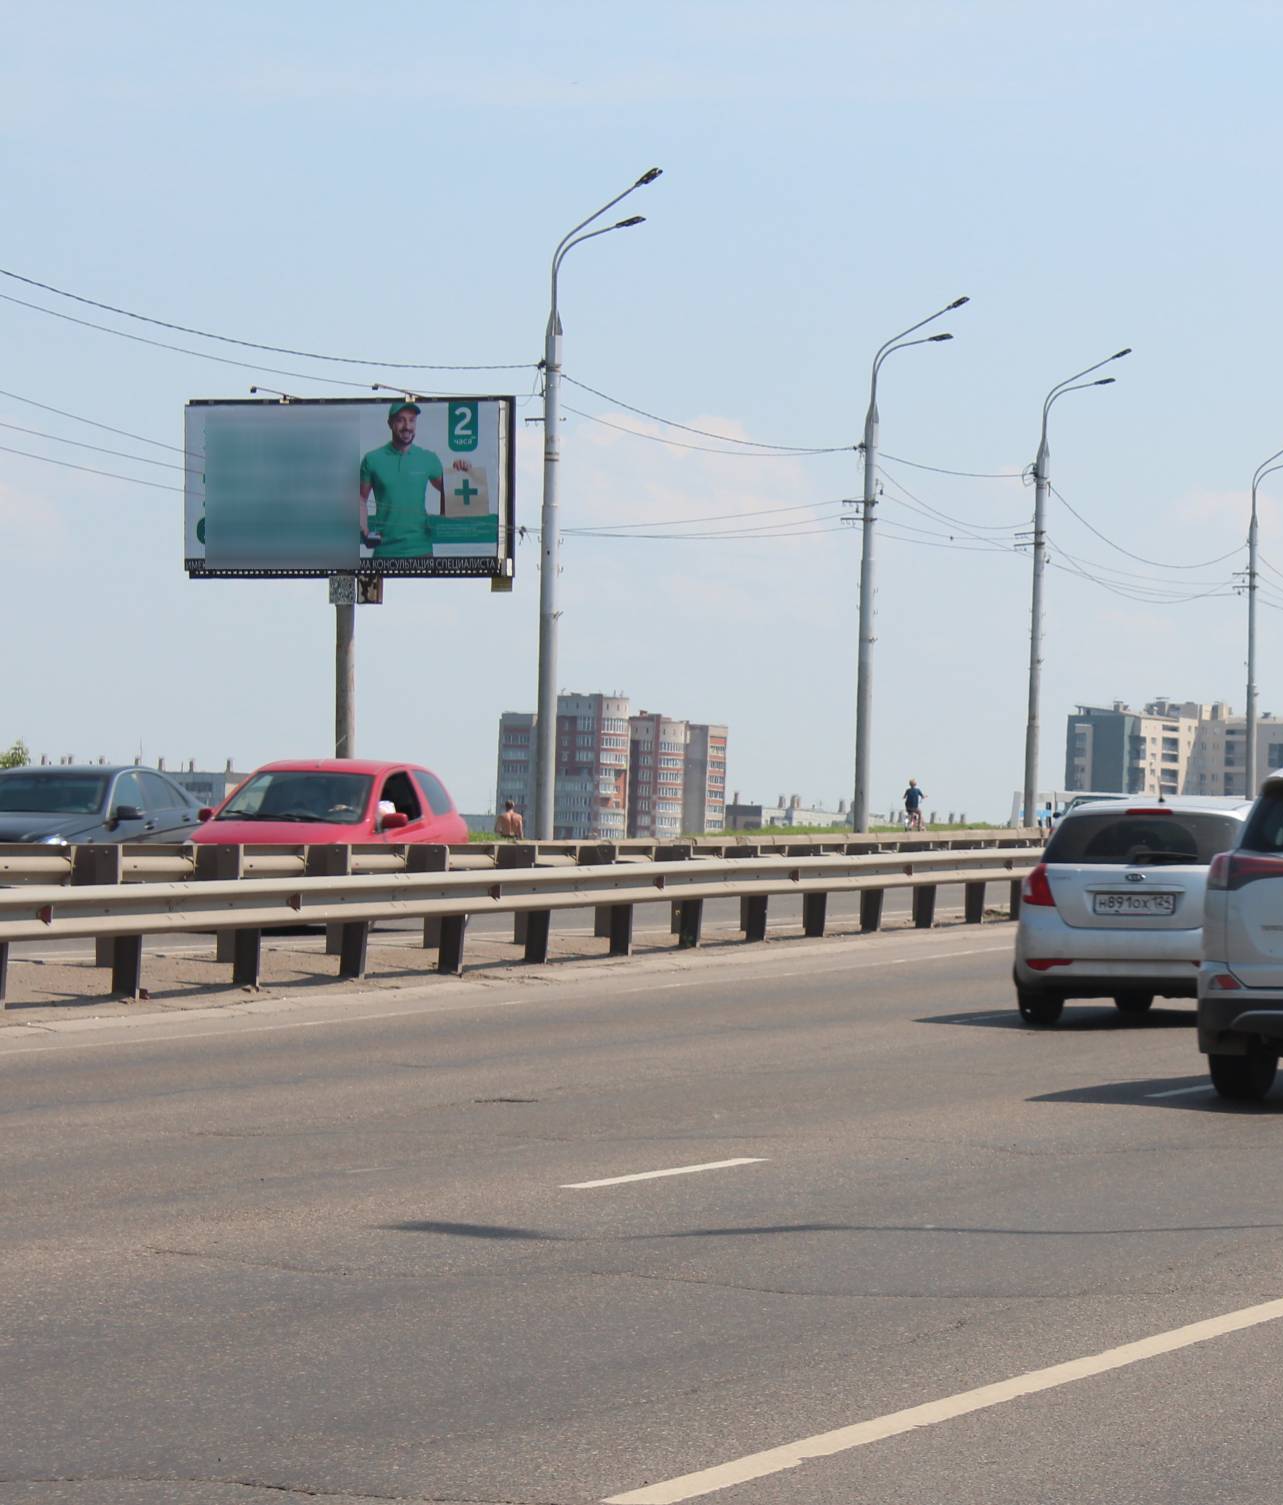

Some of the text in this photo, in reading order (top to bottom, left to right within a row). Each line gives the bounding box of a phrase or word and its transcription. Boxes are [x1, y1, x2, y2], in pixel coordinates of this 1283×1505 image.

[454, 406, 472, 436] 2
[372, 559, 434, 570] КОНСУЛЬТАЦИЯ
[435, 558, 496, 569] СПЕЦИАЛИСТА
